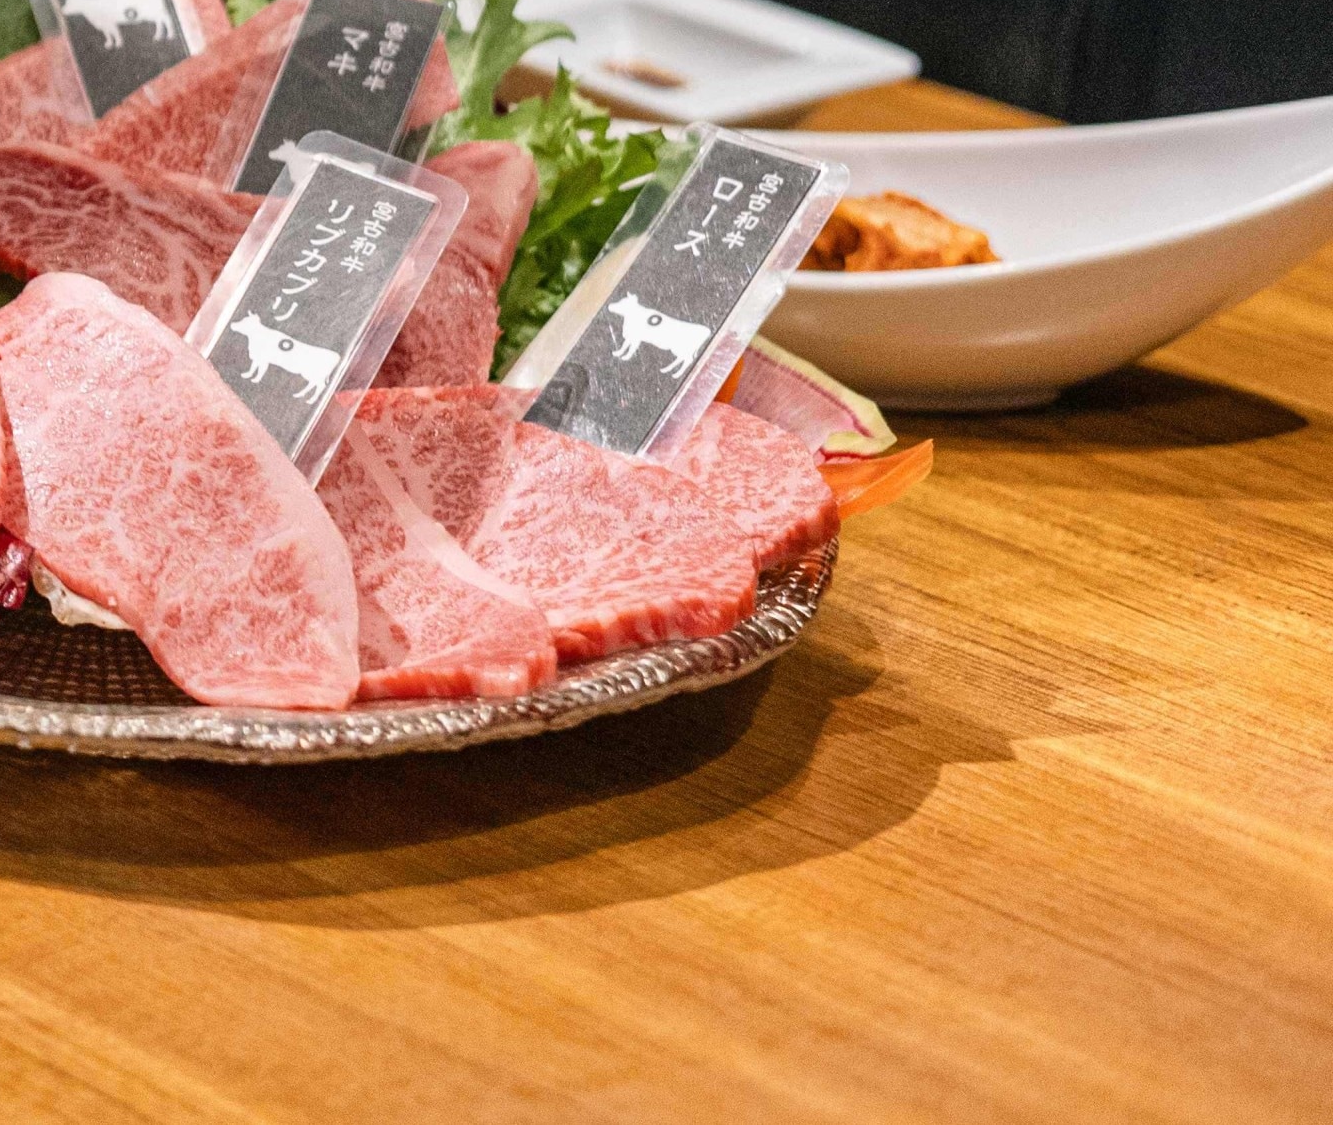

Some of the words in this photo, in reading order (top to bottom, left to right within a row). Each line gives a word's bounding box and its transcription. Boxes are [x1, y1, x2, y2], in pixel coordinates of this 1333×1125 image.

[327, 26, 370, 76] マキ
[340, 200, 398, 275] 宮古和牛
[674, 175, 744, 257] ロース
[721, 173, 783, 250] 宮古和牛
[271, 198, 354, 321] リブカブリ
